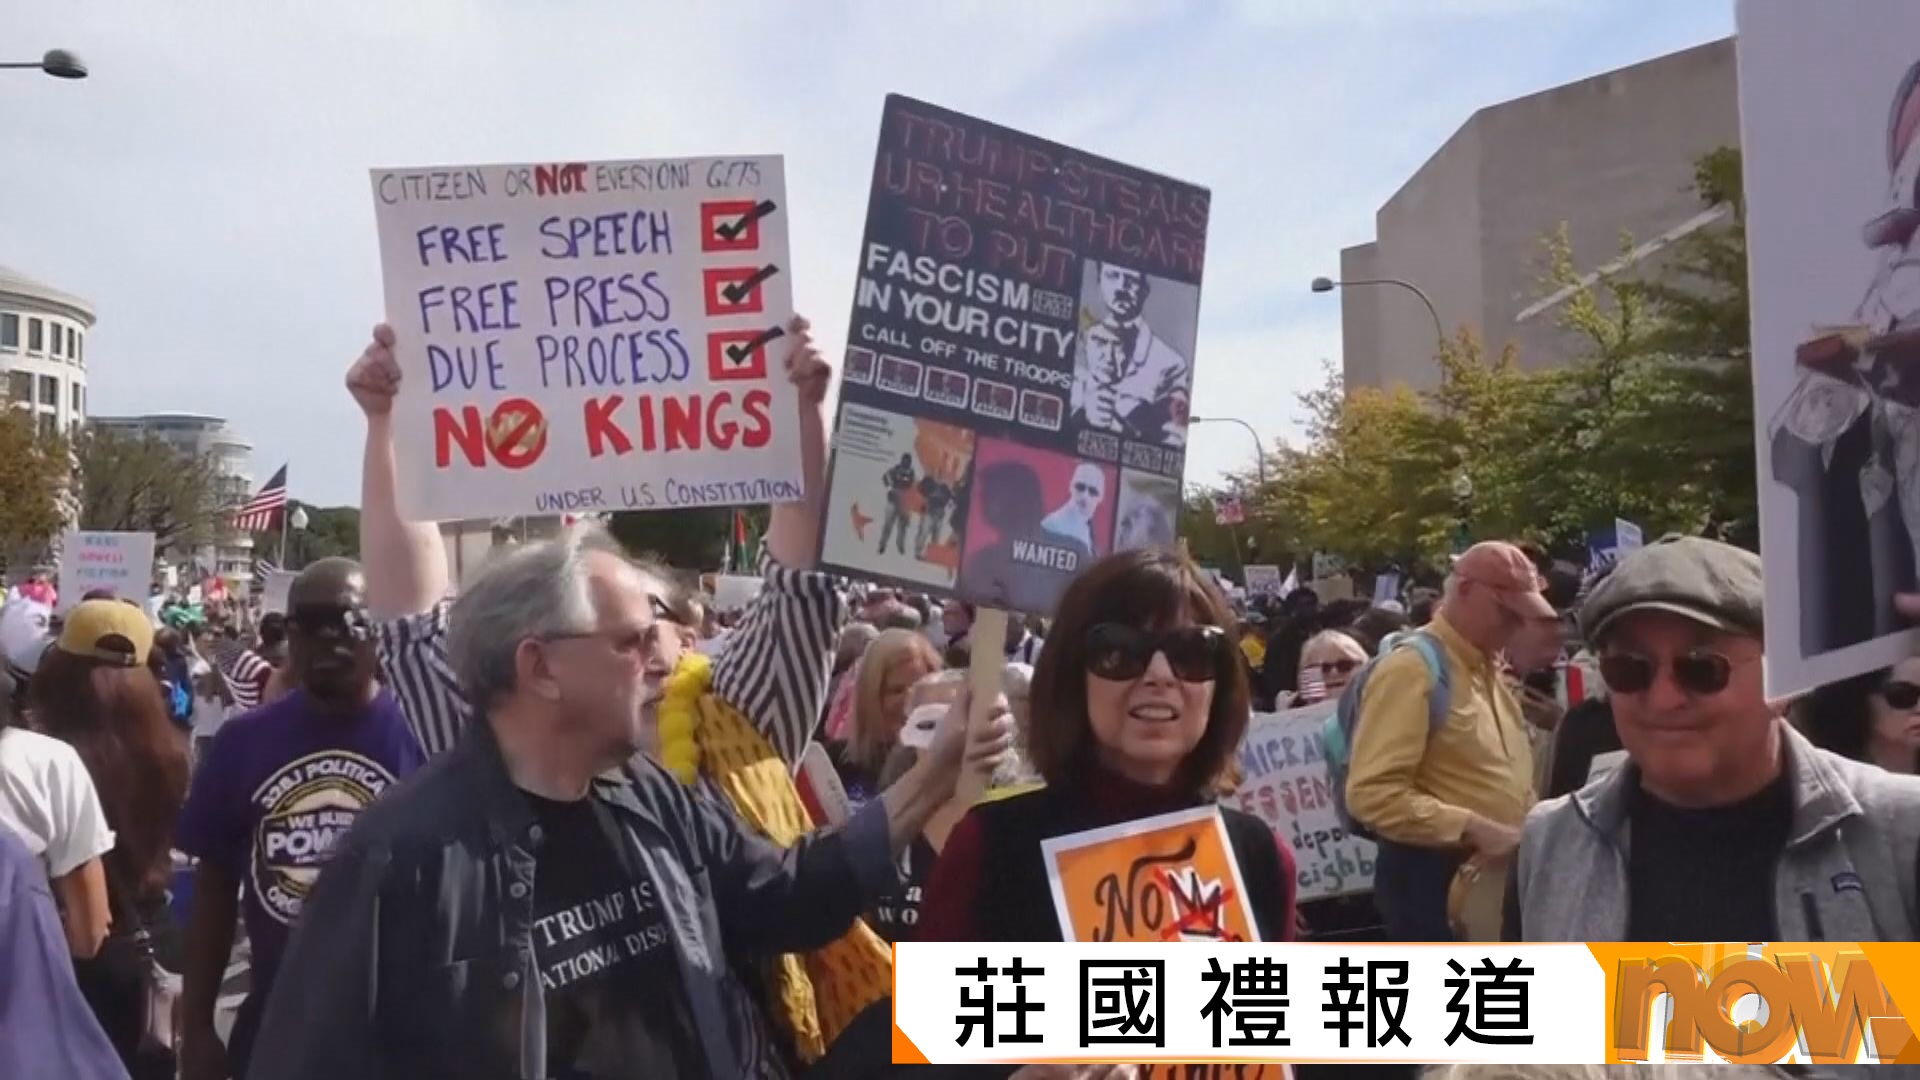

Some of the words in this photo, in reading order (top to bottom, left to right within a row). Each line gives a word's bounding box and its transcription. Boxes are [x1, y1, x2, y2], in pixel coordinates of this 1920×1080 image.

[379, 171, 487, 204] CITIZEN
[505, 169, 534, 196] OR
[535, 162, 588, 194] NOT
[896, 110, 1051, 184] TRUMP
[1062, 159, 1207, 229] STEALS
[416, 223, 508, 266] FREE
[540, 211, 673, 258] SPEECH
[906, 207, 973, 258] TO
[990, 229, 1076, 286] PUT
[952, 171, 1205, 273] HEALTHCAR
[418, 281, 522, 333] FREE
[545, 272, 671, 328] PRESS
[866, 242, 1030, 311] FASCISM
[857, 277, 892, 312] IN
[900, 288, 989, 338] YOUR
[994, 316, 1075, 359] CITY
[427, 340, 507, 392] DUE
[537, 329, 690, 388] PROCESS
[862, 324, 912, 349] CALL
[920, 337, 957, 359] OFF
[963, 347, 999, 370] THE
[1004, 357, 1073, 389] TROOPS
[433, 398, 548, 469] NO
[584, 390, 772, 457] KINGS
[535, 487, 606, 512] UNDER
[665, 478, 802, 505] CONSTITUTION
[1013, 539, 1078, 572] WANTED
[1093, 836, 1197, 942] No
[1297, 846, 1376, 891] eighb
[534, 891, 625, 947] TRUMP
[630, 882, 654, 913] IS
